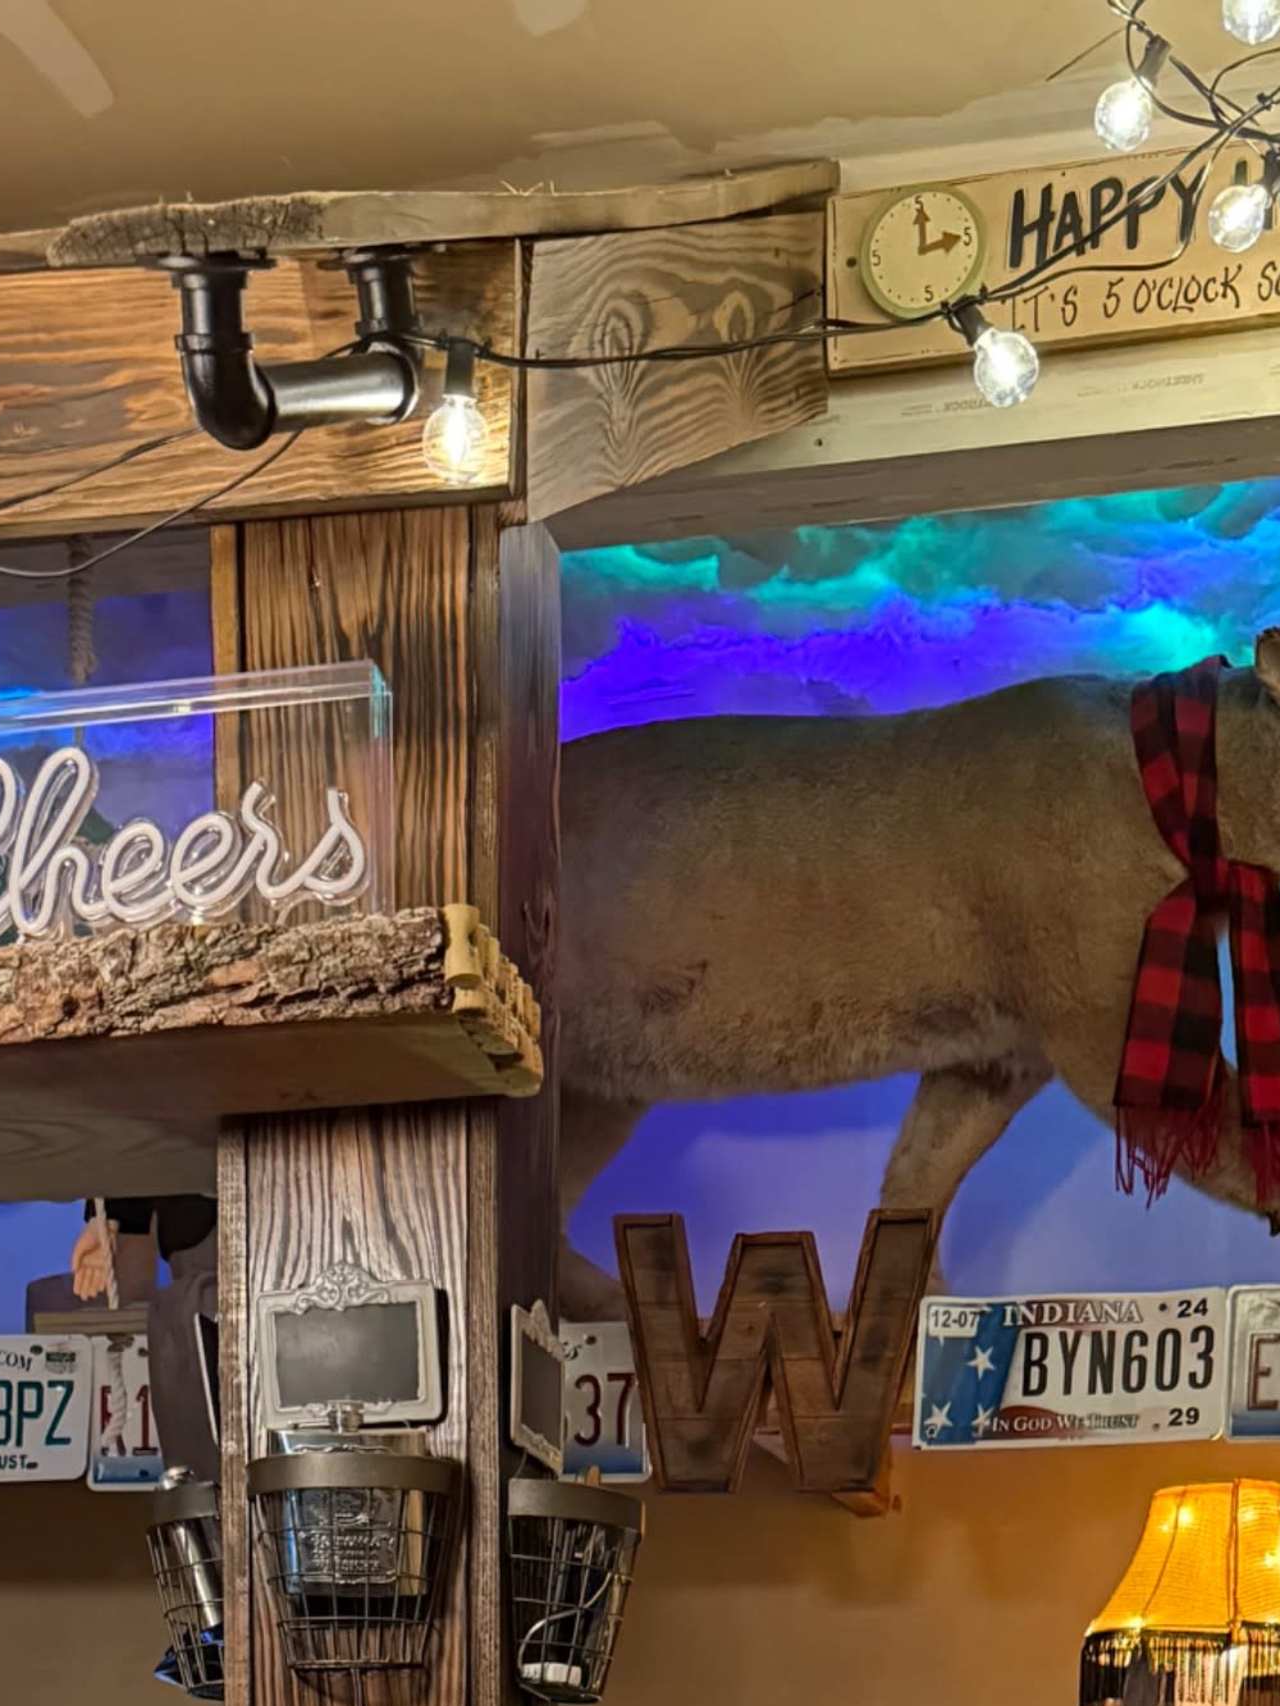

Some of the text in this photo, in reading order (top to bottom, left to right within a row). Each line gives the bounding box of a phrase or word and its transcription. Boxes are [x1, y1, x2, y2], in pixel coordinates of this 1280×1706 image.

[1009, 166, 1210, 268] HAPPY
[1004, 287, 1078, 332] IT'S
[1103, 276, 1123, 318] 5
[1132, 263, 1243, 315] O'CLOCK
[931, 1309, 978, 1329] 12-07
[1003, 1298, 1209, 1327] INDIANA 24
[613, 1208, 942, 1493] W
[1021, 1324, 1216, 1398] BYN603
[992, 1415, 1010, 1433] IN
[1013, 1412, 1053, 1432] GOD
[1168, 1407, 1201, 1428] 29
